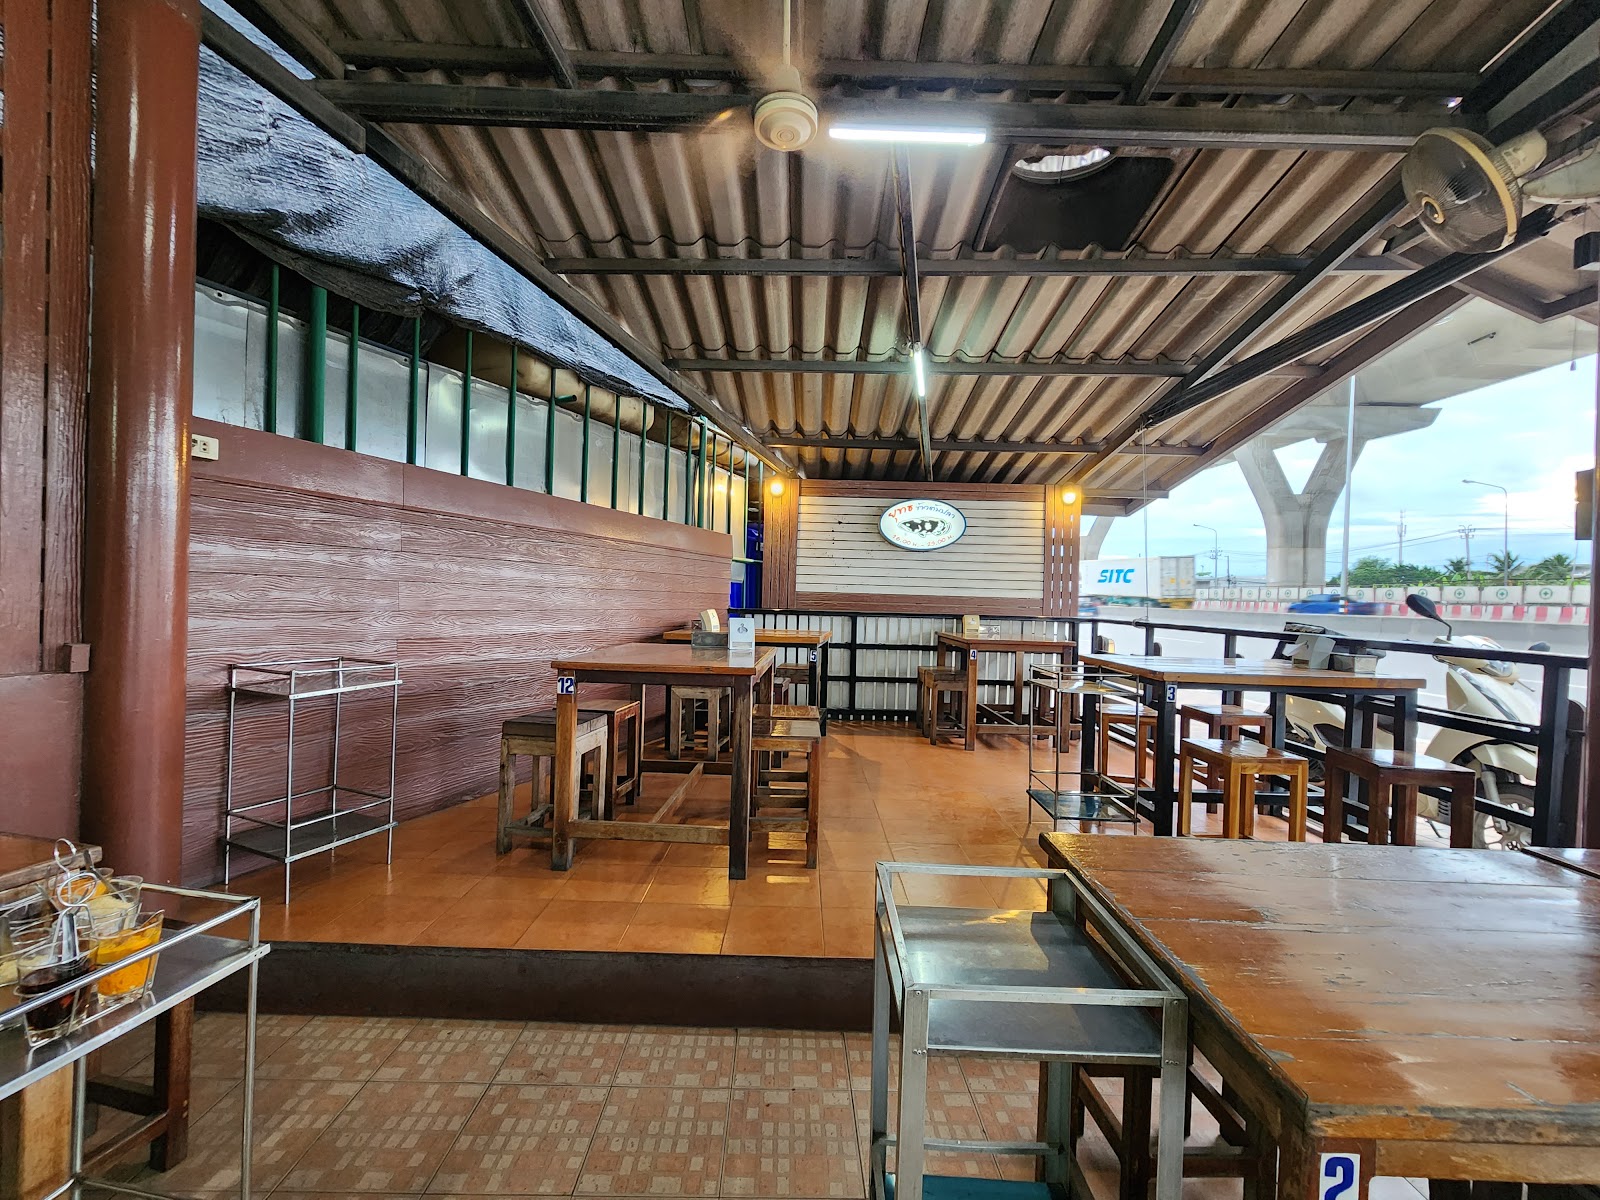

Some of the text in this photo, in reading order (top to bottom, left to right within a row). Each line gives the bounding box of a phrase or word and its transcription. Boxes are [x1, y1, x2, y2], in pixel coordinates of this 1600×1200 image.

[1097, 569, 1135, 583] SITC
[811, 650, 816, 660] 5
[971, 650, 976, 659] 4
[558, 677, 574, 694] 12
[1167, 686, 1176, 701] 3
[1324, 1156, 1355, 1200] 2
